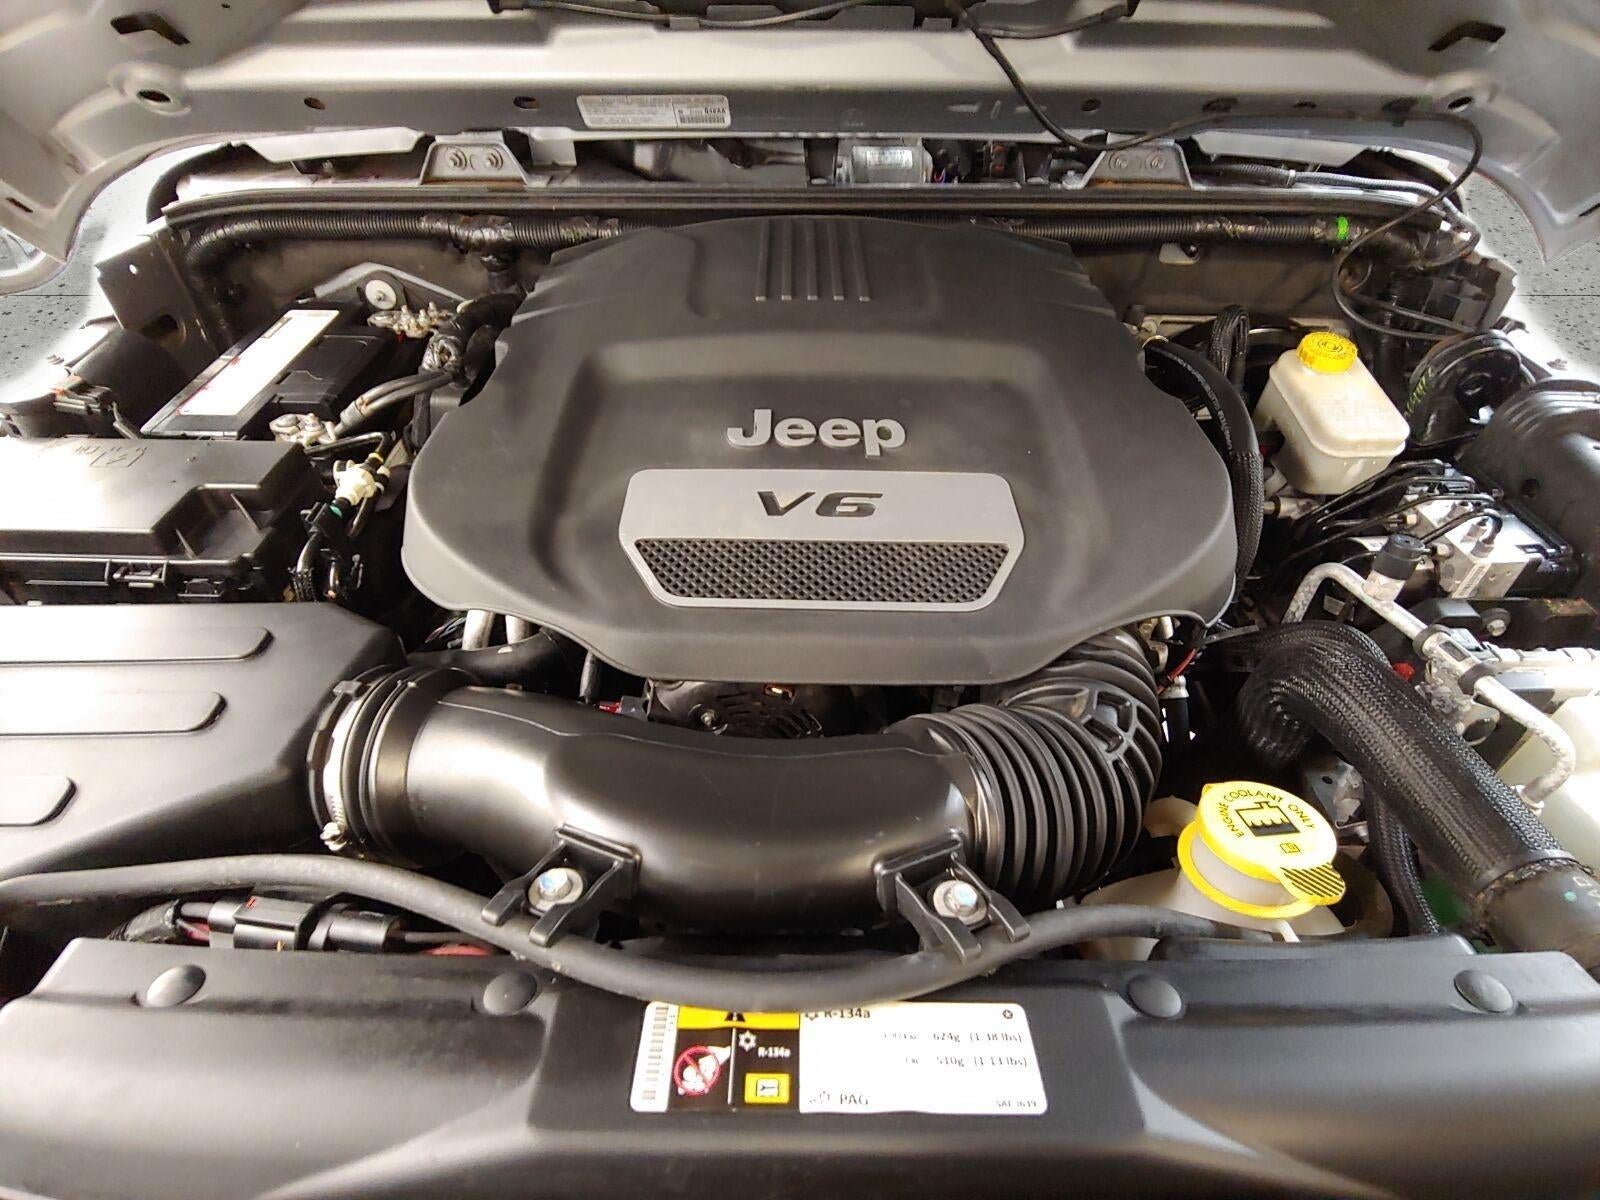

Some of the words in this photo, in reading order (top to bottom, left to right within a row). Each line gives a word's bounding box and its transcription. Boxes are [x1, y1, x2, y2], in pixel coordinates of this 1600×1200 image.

[727, 408, 906, 458] Jeep
[757, 490, 883, 517] V6
[1223, 789, 1283, 803] COOLANT
[1217, 802, 1245, 838] ENGINE
[1287, 803, 1316, 829] ONLY
[757, 1046, 792, 1058] R-134a
